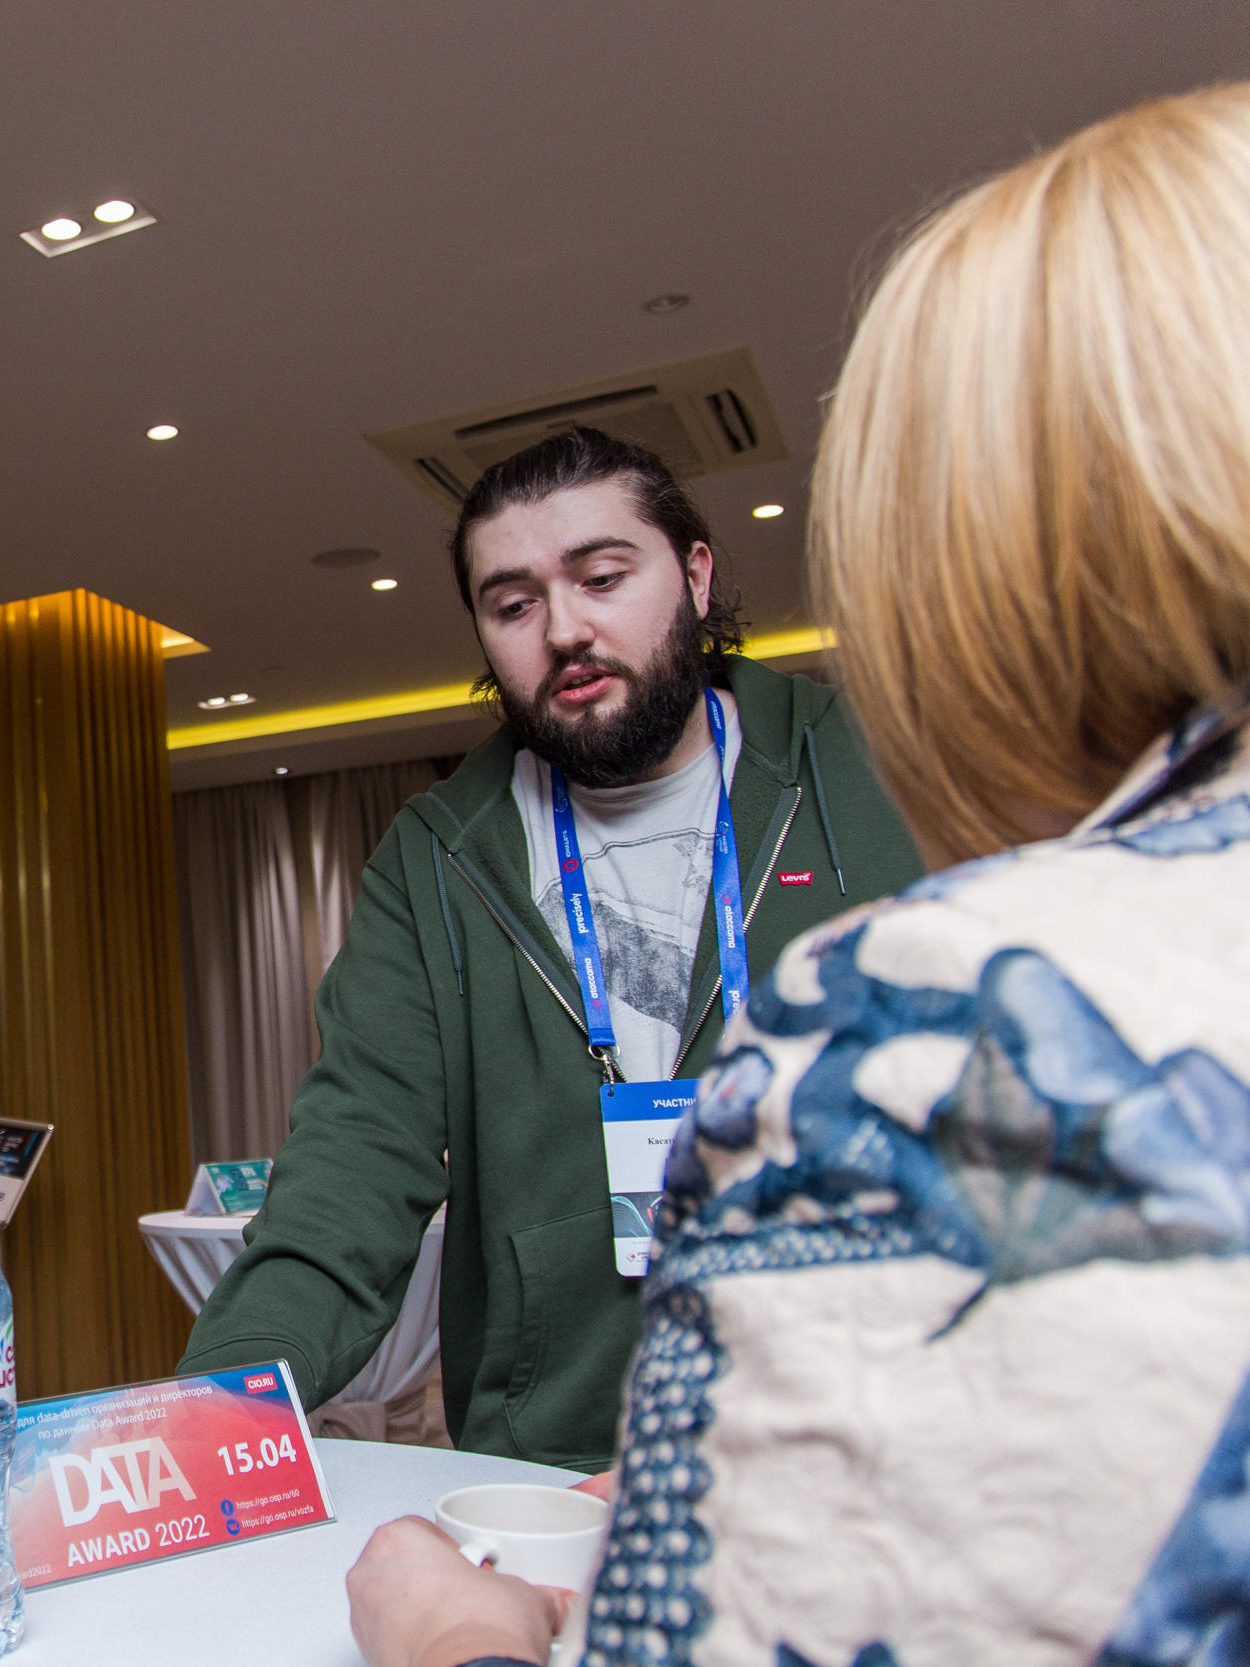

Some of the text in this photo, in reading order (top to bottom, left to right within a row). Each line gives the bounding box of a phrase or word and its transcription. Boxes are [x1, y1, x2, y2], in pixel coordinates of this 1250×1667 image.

[570, 893, 590, 935] precisely
[724, 905, 736, 949] ataccama
[584, 957, 599, 999] ataccama
[652, 1097, 697, 1109] УЧАСТНИ
[247, 1376, 274, 1390] CIO.RU
[17, 1385, 213, 1430] для data-driven организаций и директоров
[38, 1407, 168, 1440] по данным Data Award 2022
[217, 1433, 297, 1476] 15.04
[48, 1436, 197, 1528] DATA
[67, 1514, 210, 1567] AWARD 2022
